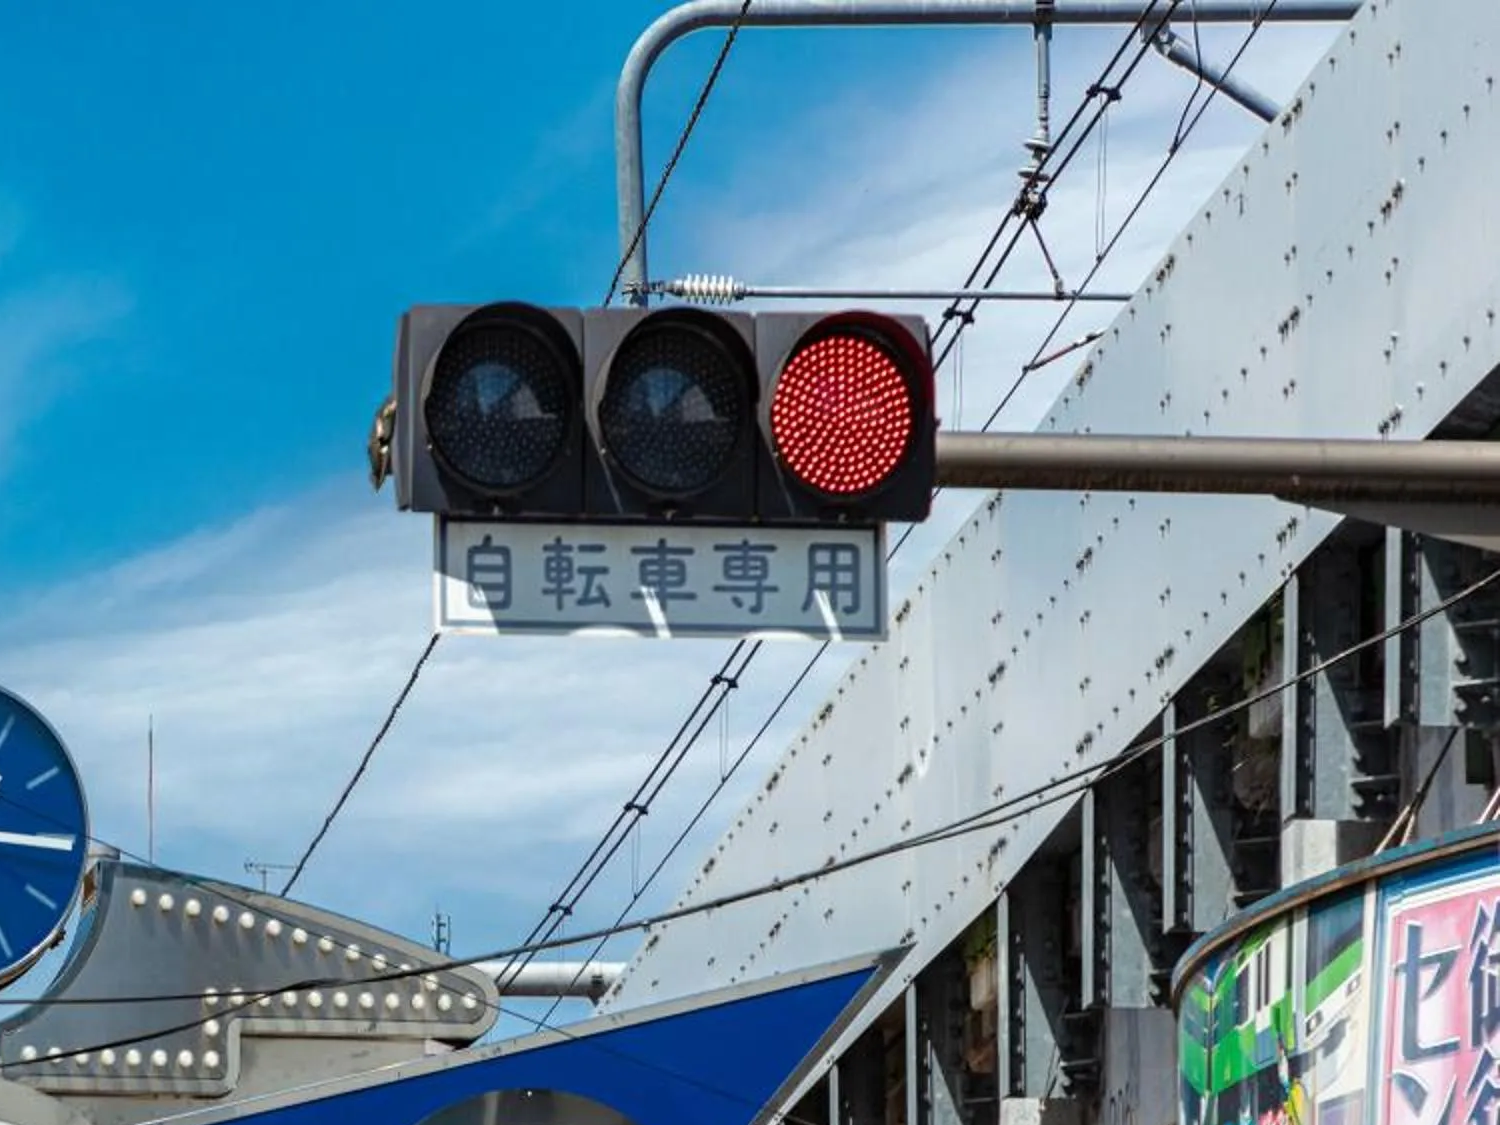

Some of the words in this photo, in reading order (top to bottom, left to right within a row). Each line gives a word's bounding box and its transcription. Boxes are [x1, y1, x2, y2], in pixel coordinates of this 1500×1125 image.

[466, 535, 863, 615] 自転車専用
